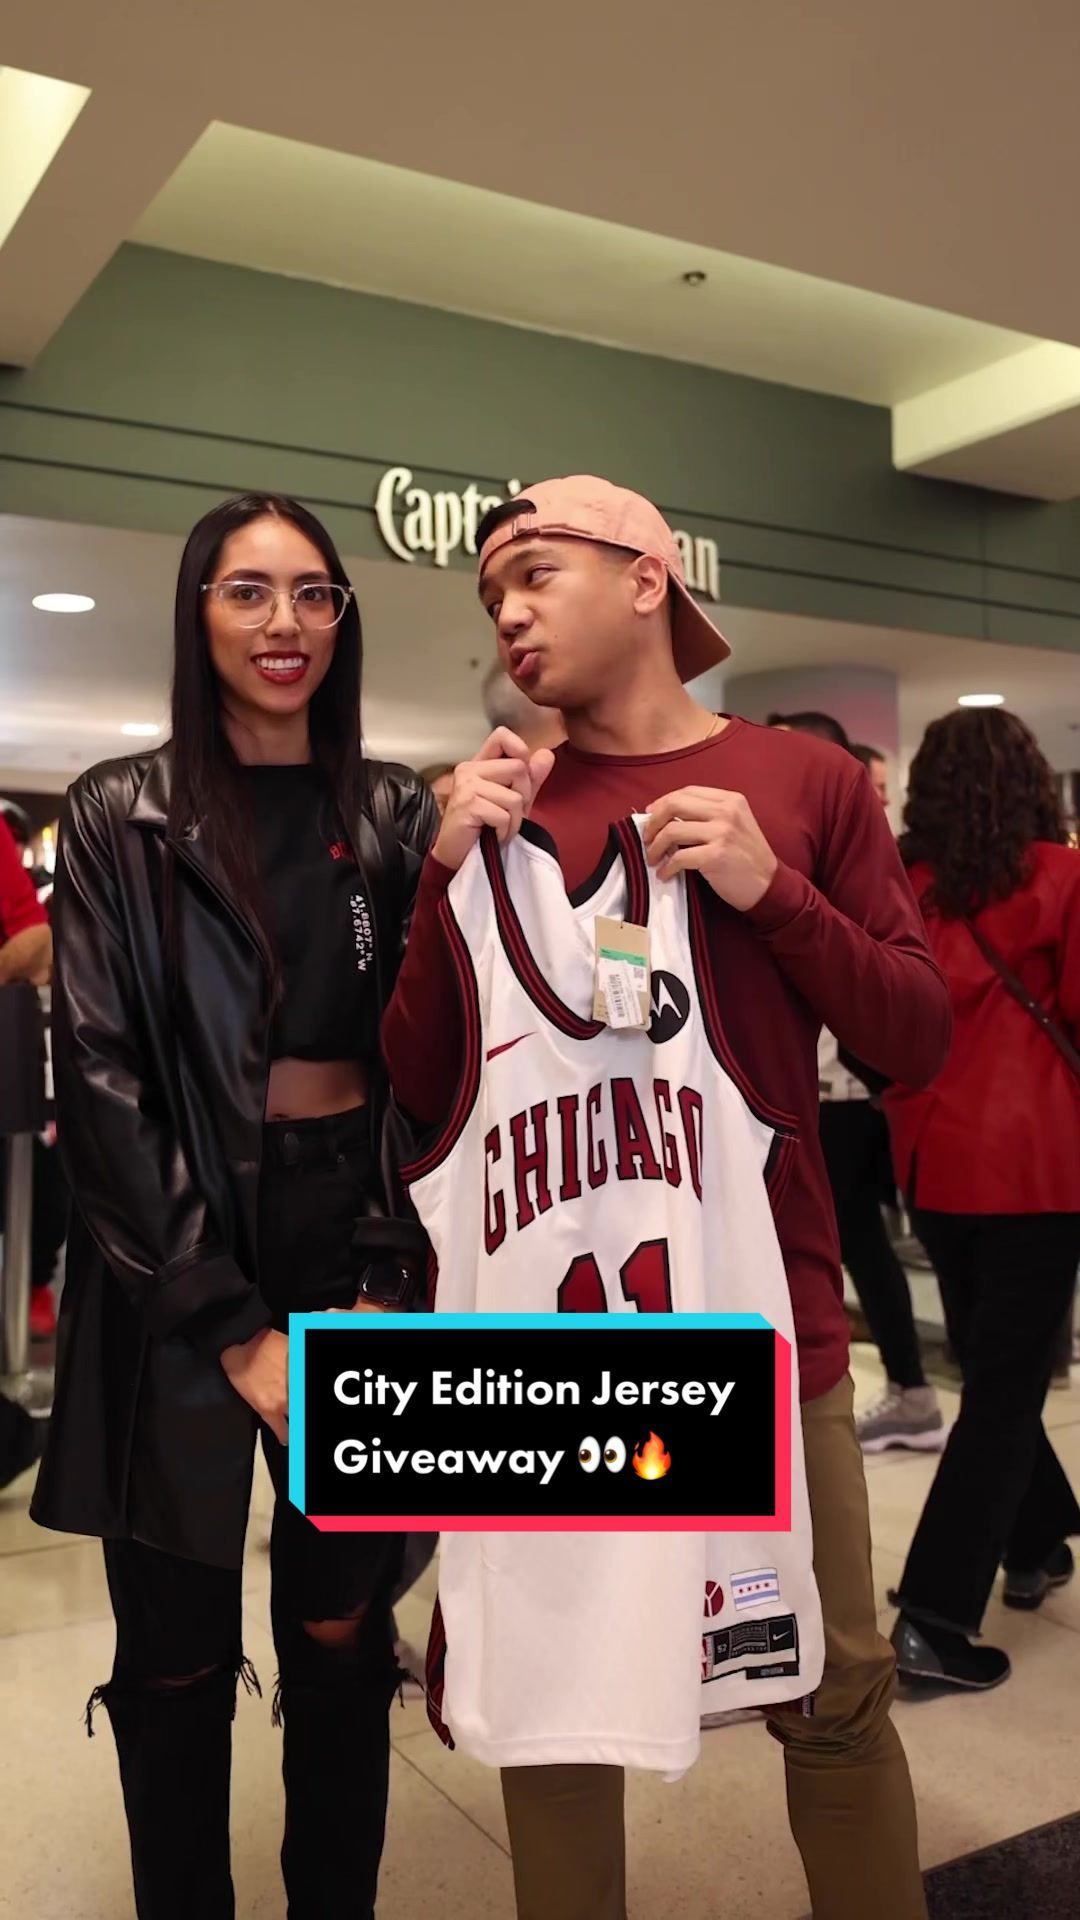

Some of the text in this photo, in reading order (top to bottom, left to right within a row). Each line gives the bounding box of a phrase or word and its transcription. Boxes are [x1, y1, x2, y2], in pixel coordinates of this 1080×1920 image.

[374, 466, 720, 600] Capt an
[358, 959, 367, 972] W
[365, 952, 373, 962] N
[484, 1077, 703, 1257] CHICAGO
